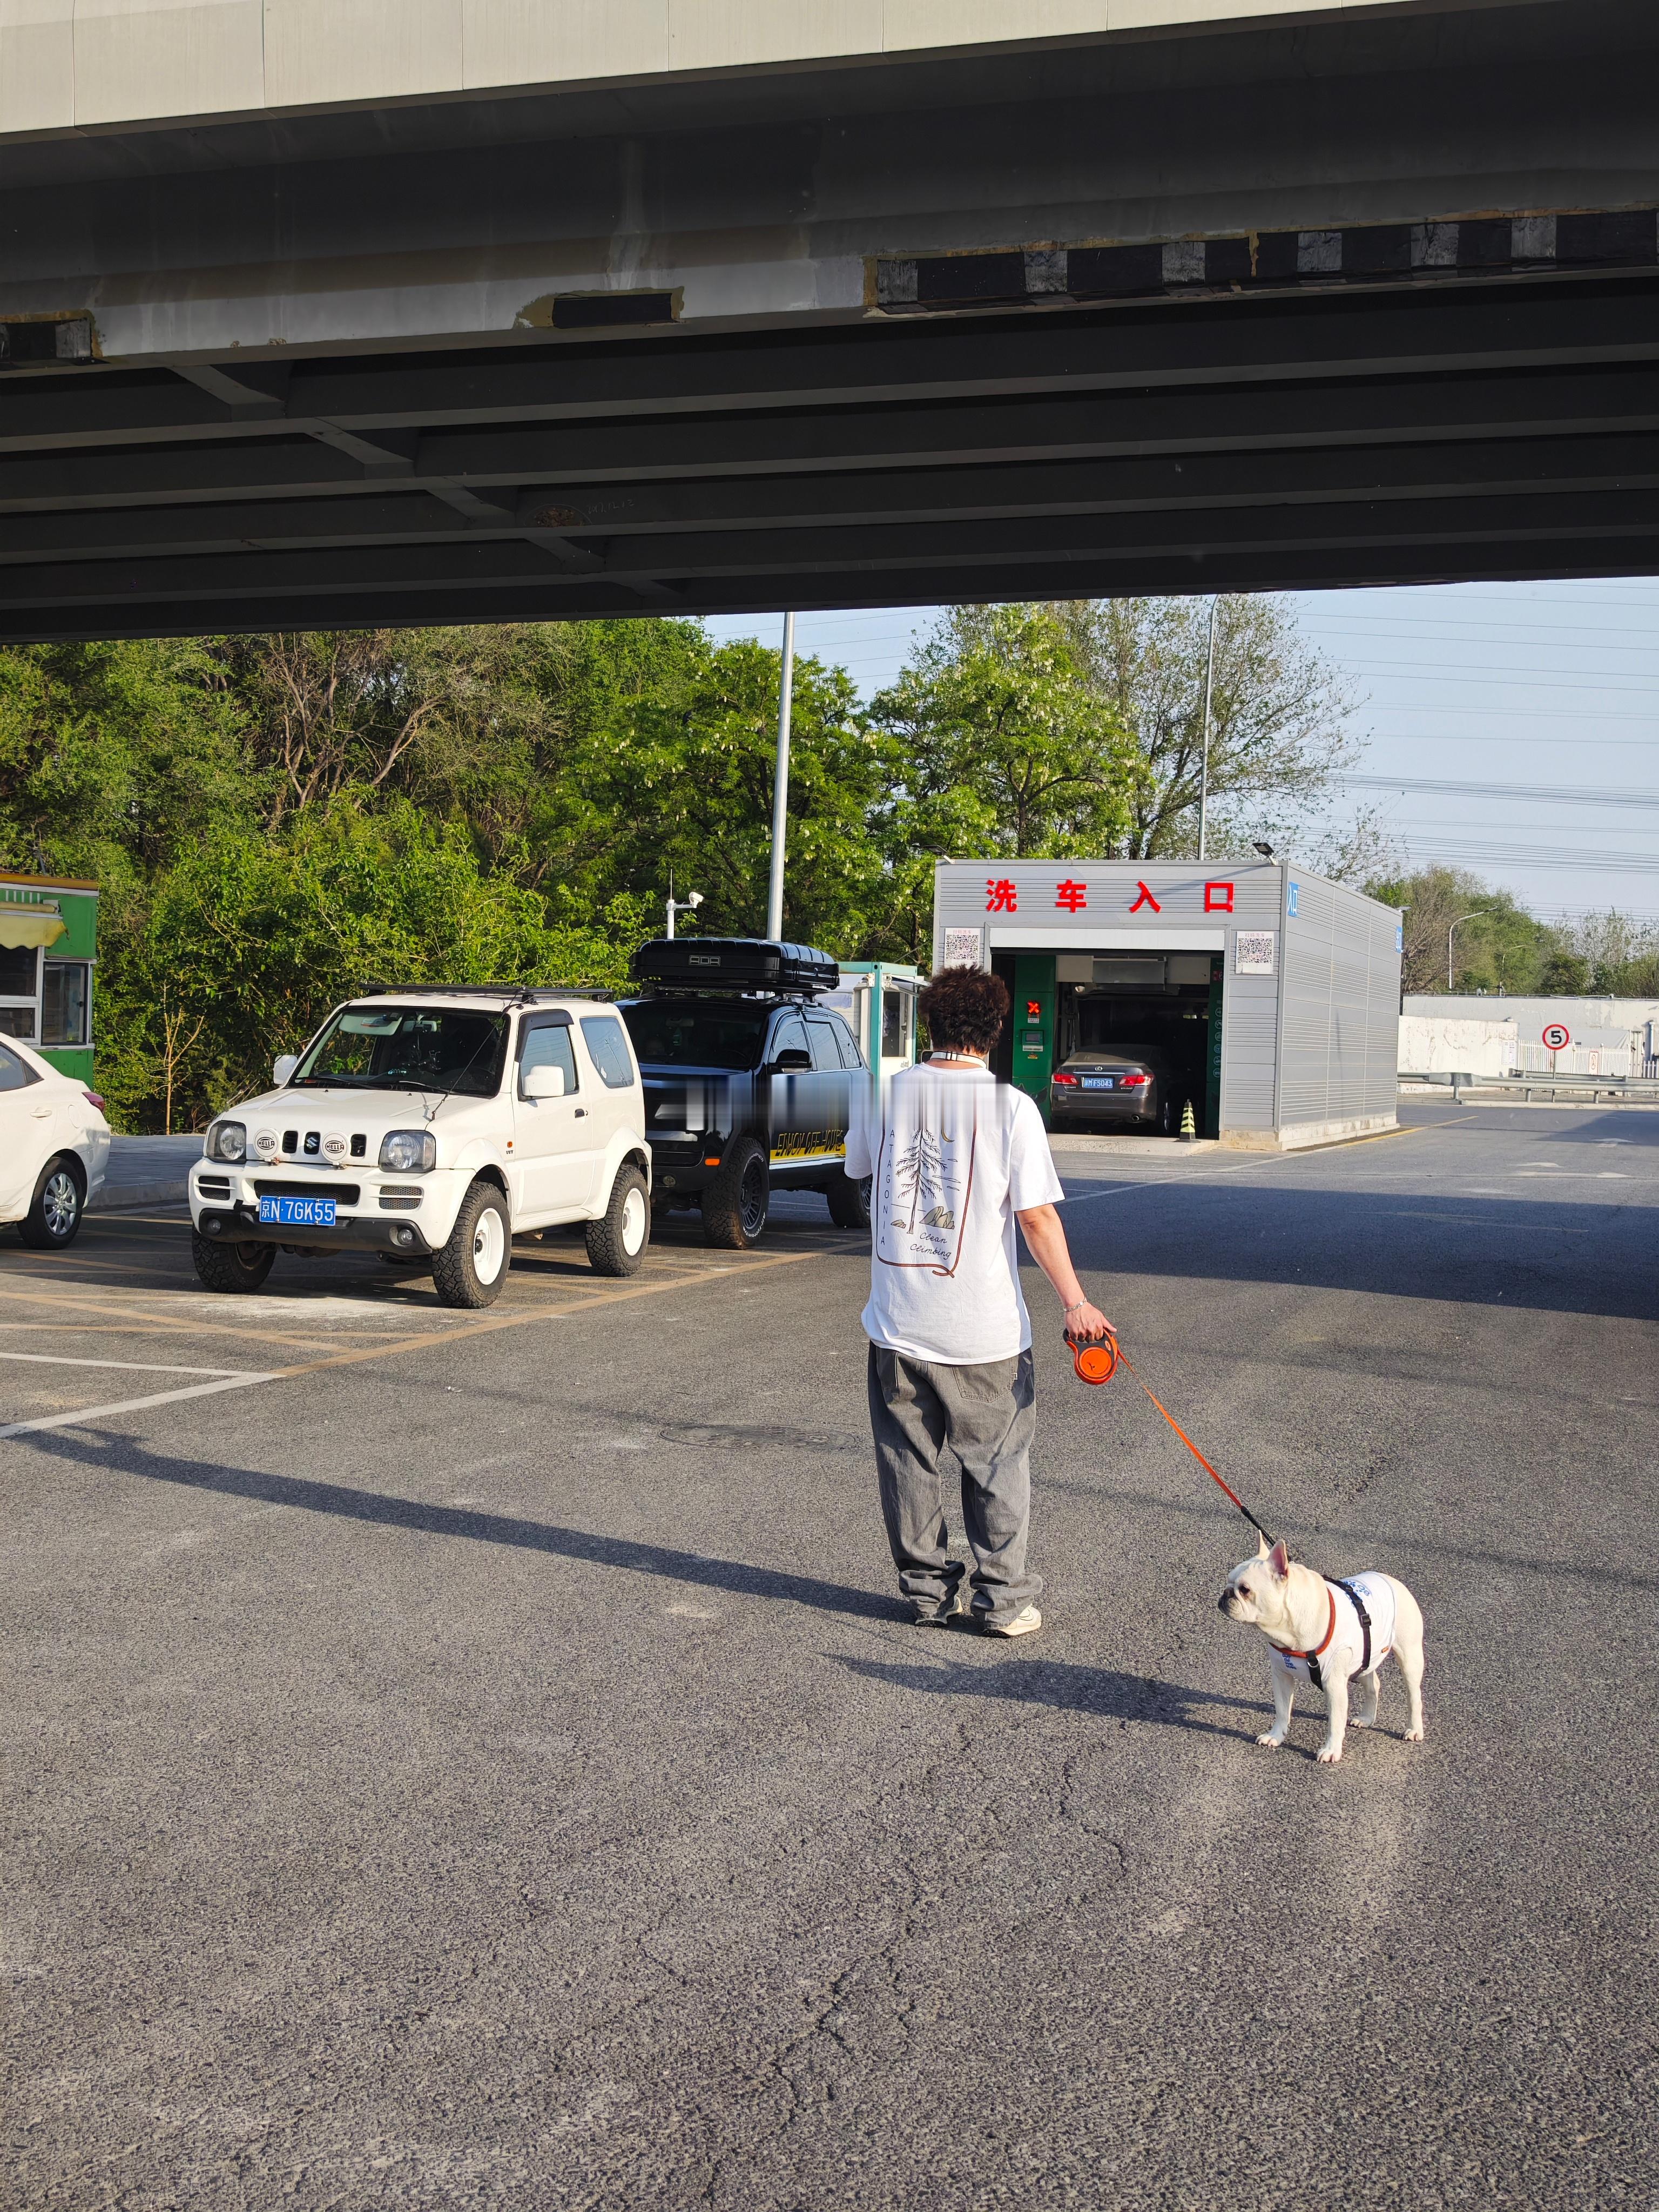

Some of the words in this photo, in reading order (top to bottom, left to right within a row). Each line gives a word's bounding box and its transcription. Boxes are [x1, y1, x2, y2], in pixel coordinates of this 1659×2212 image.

[986, 879, 1235, 913] 洗车入口
[1287, 884, 1297, 915] 入口
[1550, 1030, 1562, 1044] 5
[261, 1200, 334, 1222] 京N·7GK55
[920, 1232, 947, 1244] Clean
[910, 1244, 952, 1260] Climbing
